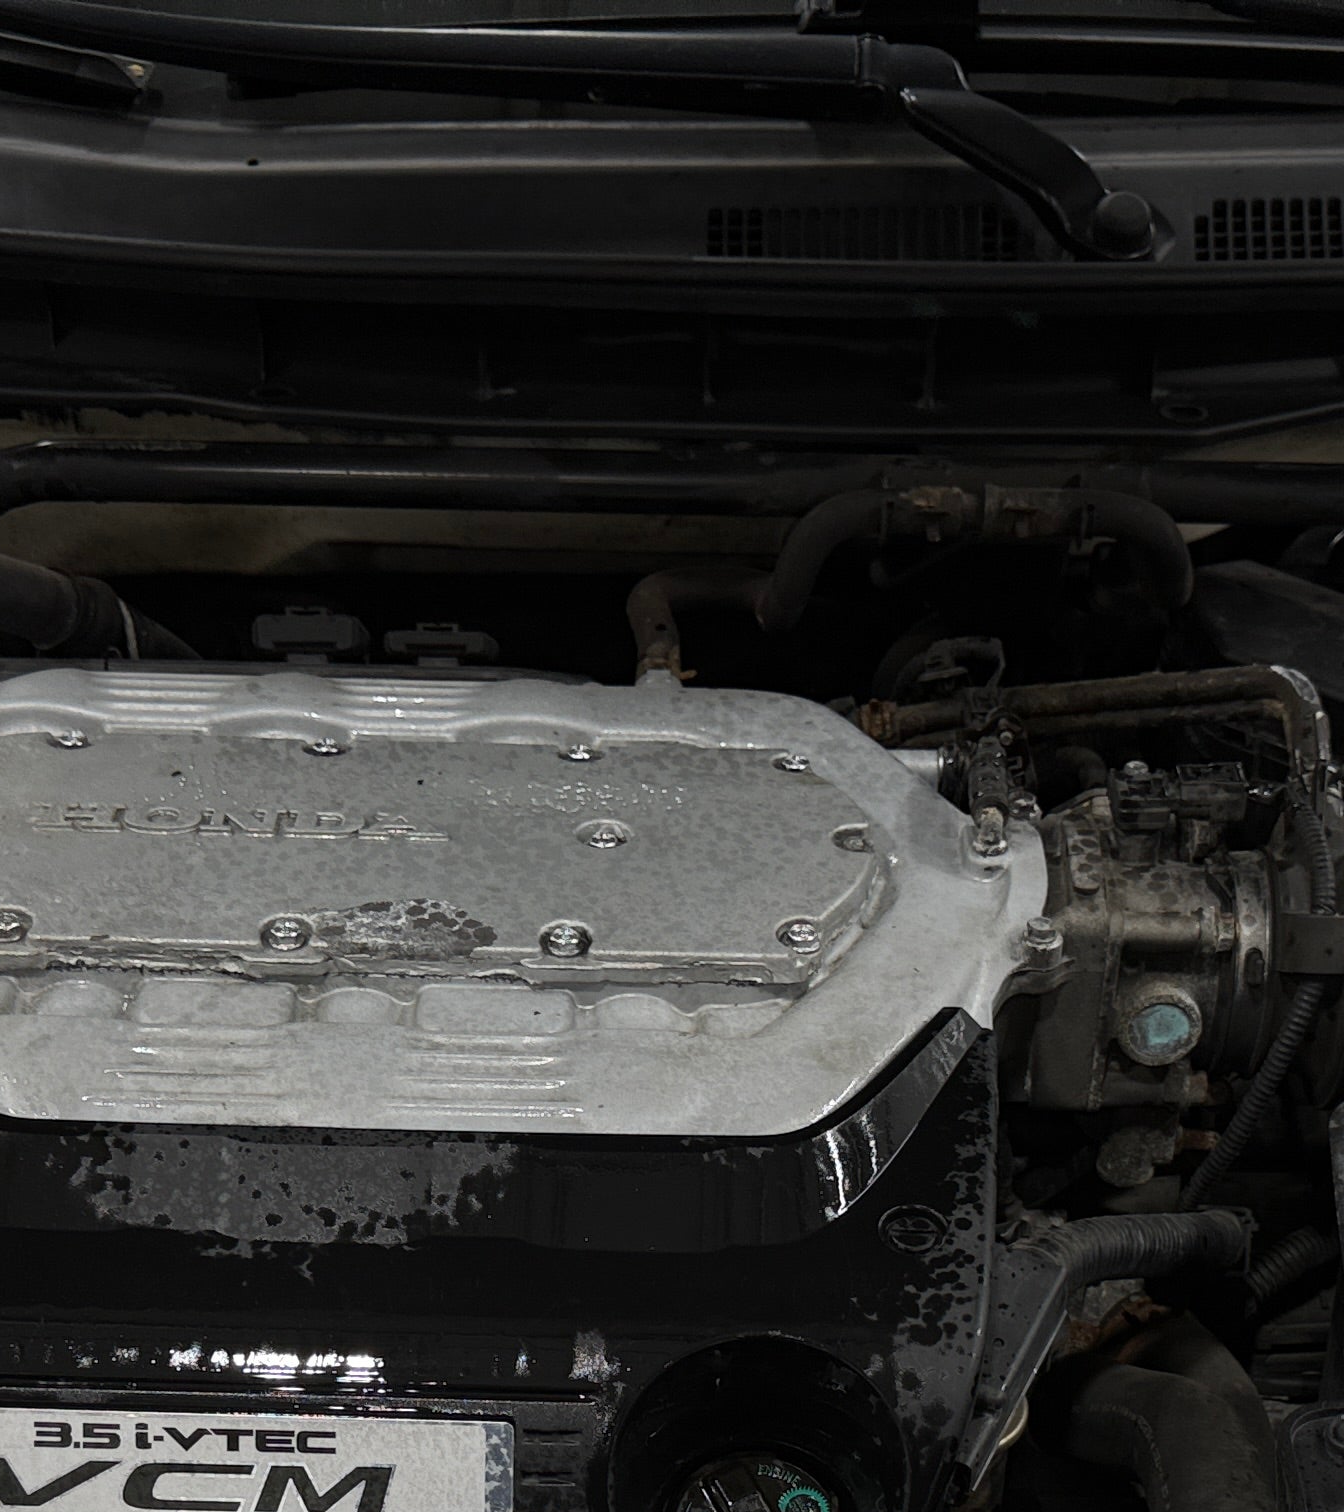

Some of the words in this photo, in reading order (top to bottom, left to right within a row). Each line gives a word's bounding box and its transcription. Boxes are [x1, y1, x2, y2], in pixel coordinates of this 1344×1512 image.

[33, 801, 451, 842] HONDA
[33, 1421, 121, 1450] 3.5
[133, 1422, 337, 1455] i-VTEC
[757, 1463, 802, 1488] ENGINE
